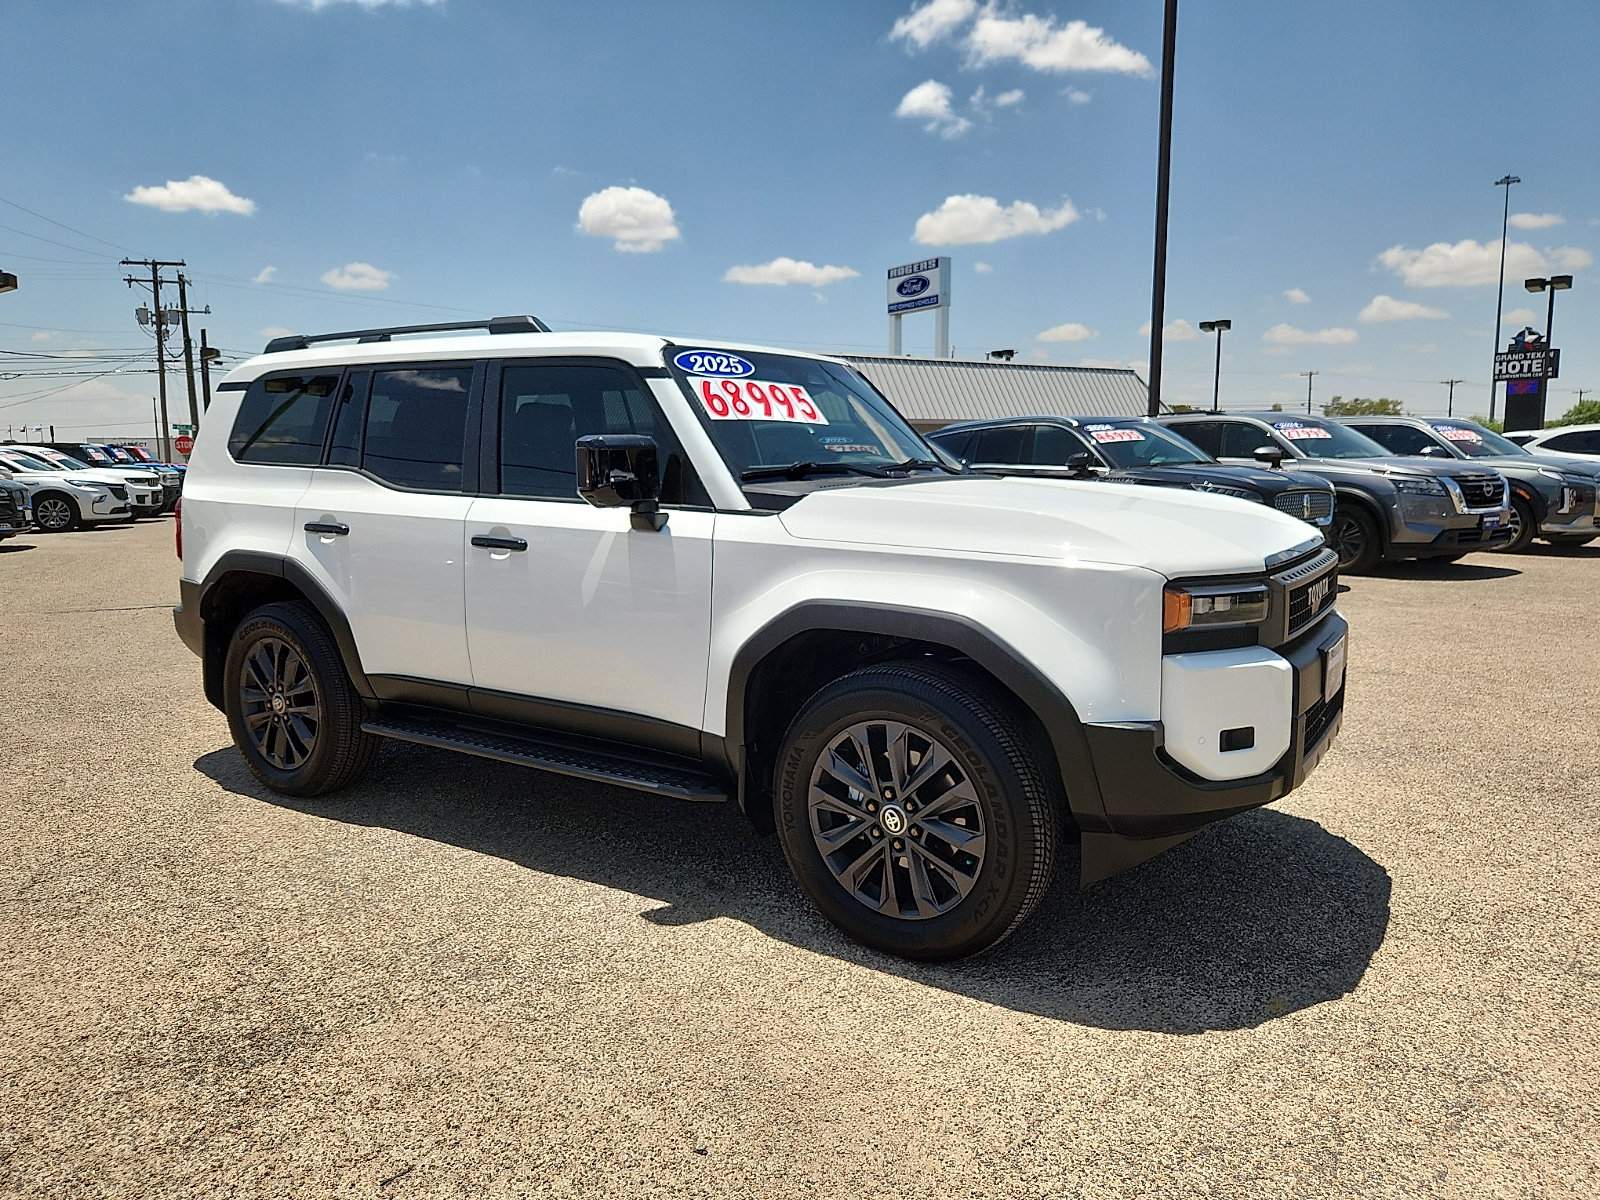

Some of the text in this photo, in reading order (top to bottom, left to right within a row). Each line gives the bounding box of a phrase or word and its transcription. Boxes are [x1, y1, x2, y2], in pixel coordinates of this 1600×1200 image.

[889, 259, 937, 278] ROGERS
[902, 279, 923, 294] Ford
[915, 296, 937, 307] VEHICLES
[689, 355, 744, 373] 2025
[1495, 352, 1525, 361] GRAND
[699, 379, 821, 422] 68995
[176, 441, 194, 449] STOP
[1307, 576, 1329, 606] TOYOTA
[781, 746, 805, 832] YOKOHAMA
[940, 723, 1009, 880] GEOLANDAR
